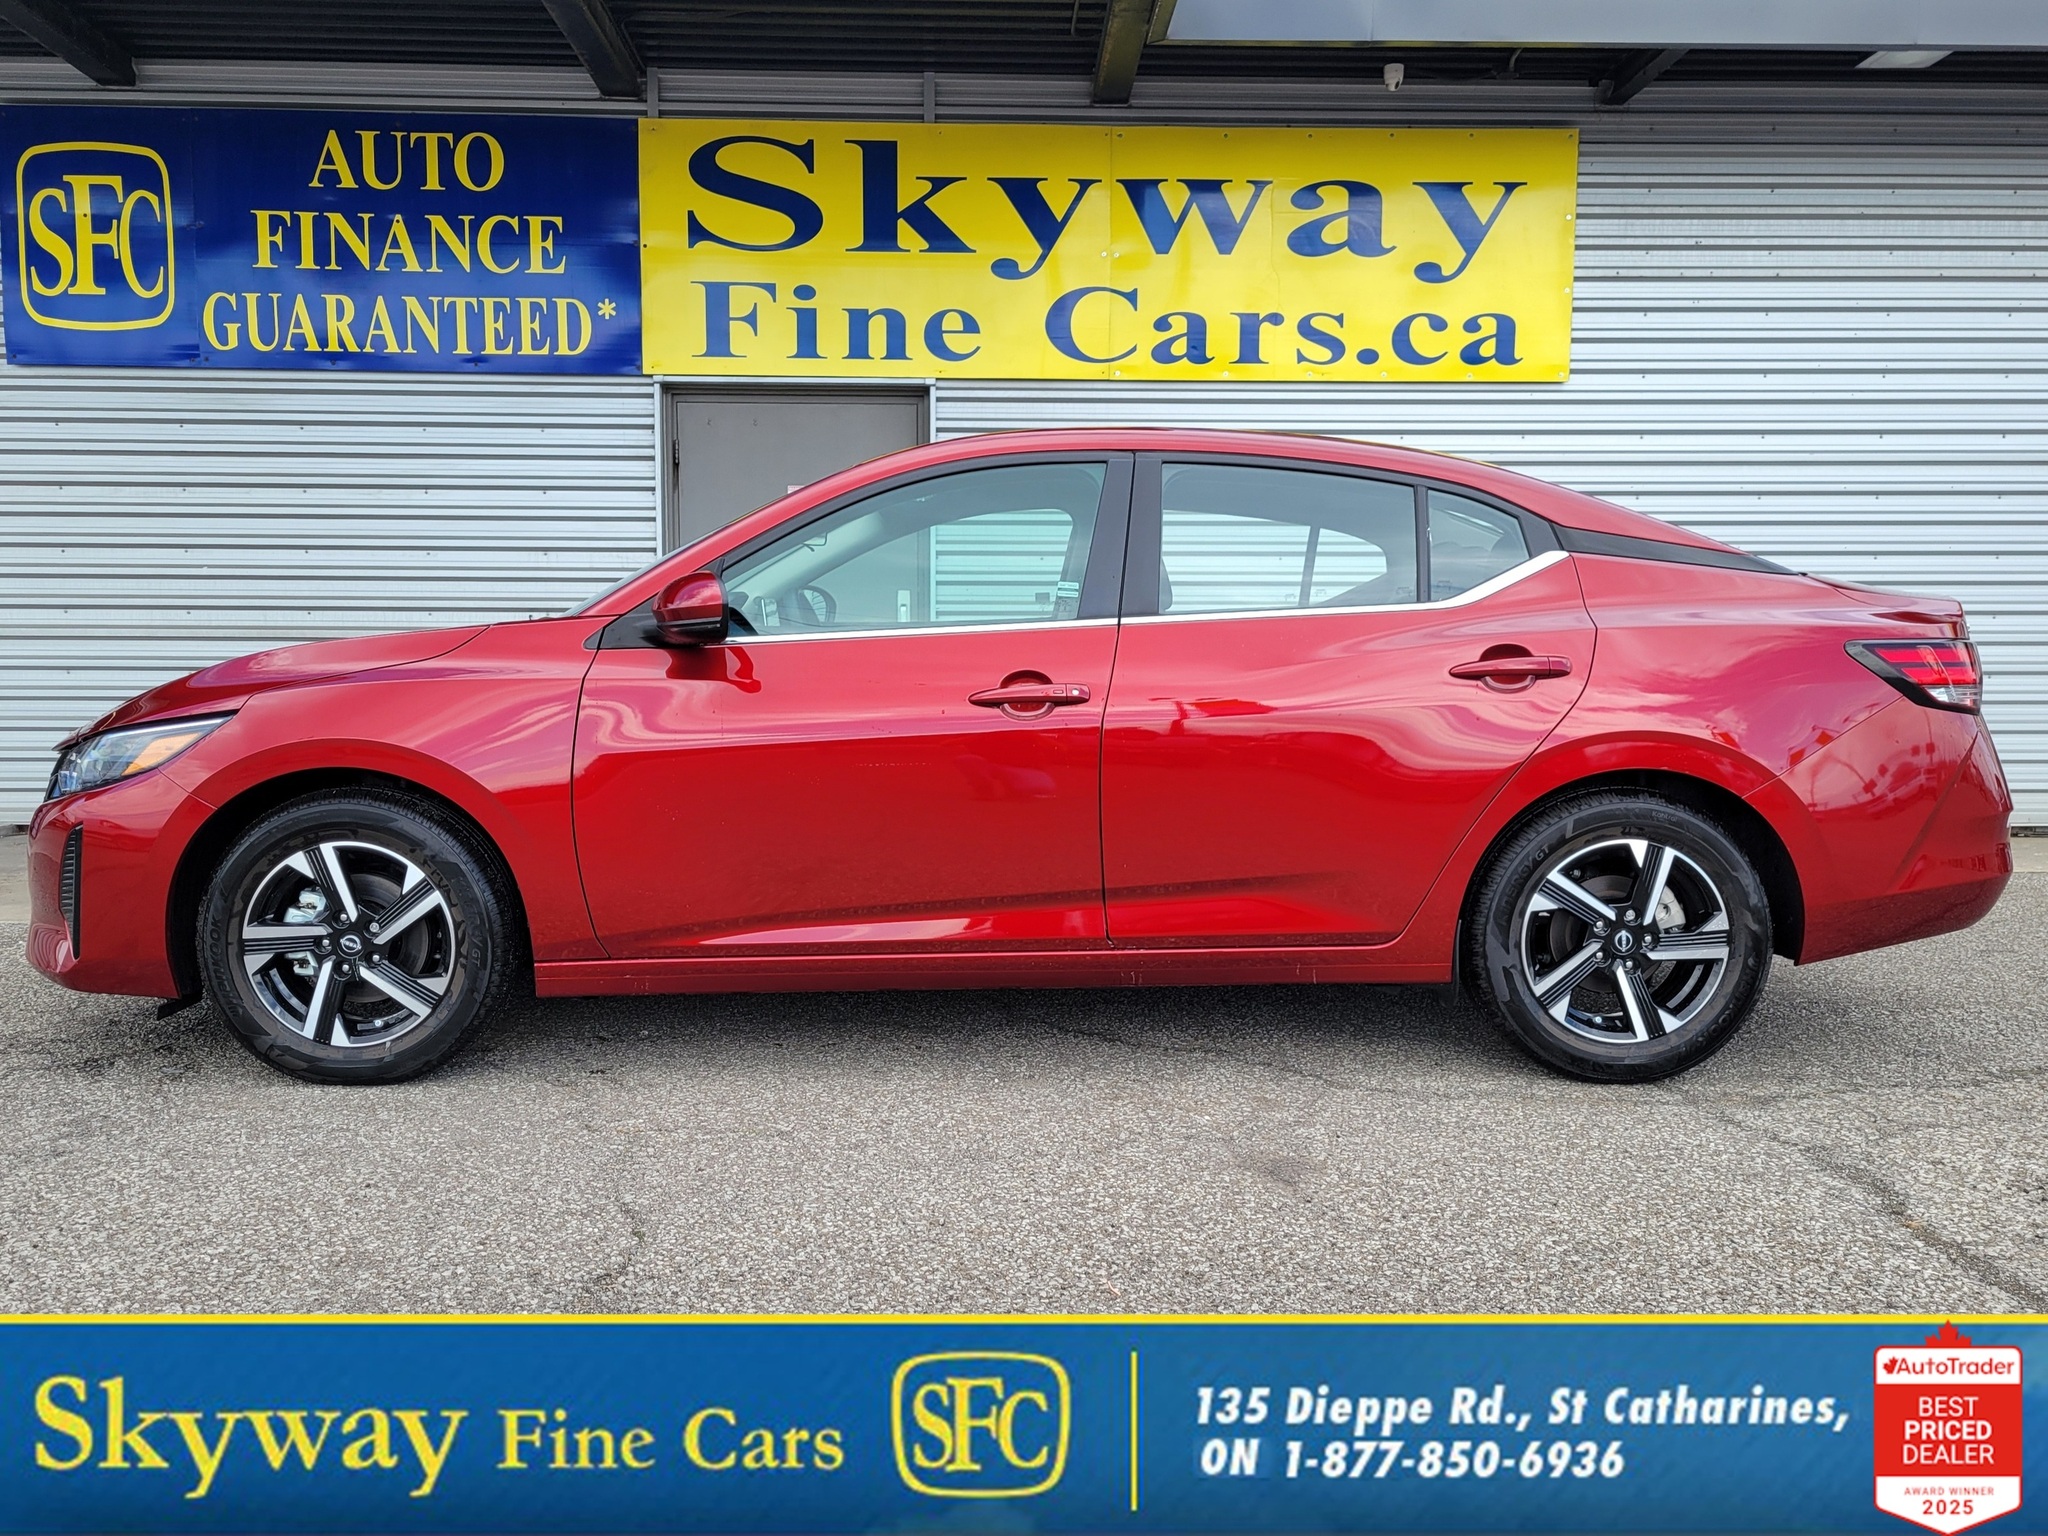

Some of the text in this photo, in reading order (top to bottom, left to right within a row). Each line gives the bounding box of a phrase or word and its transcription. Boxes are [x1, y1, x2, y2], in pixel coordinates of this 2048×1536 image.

[311, 130, 505, 191] AUTO
[29, 175, 164, 298] SFC
[251, 210, 567, 274] FINANCE
[687, 135, 1528, 283] Skyway
[692, 281, 1523, 366] Fine Cars.ca
